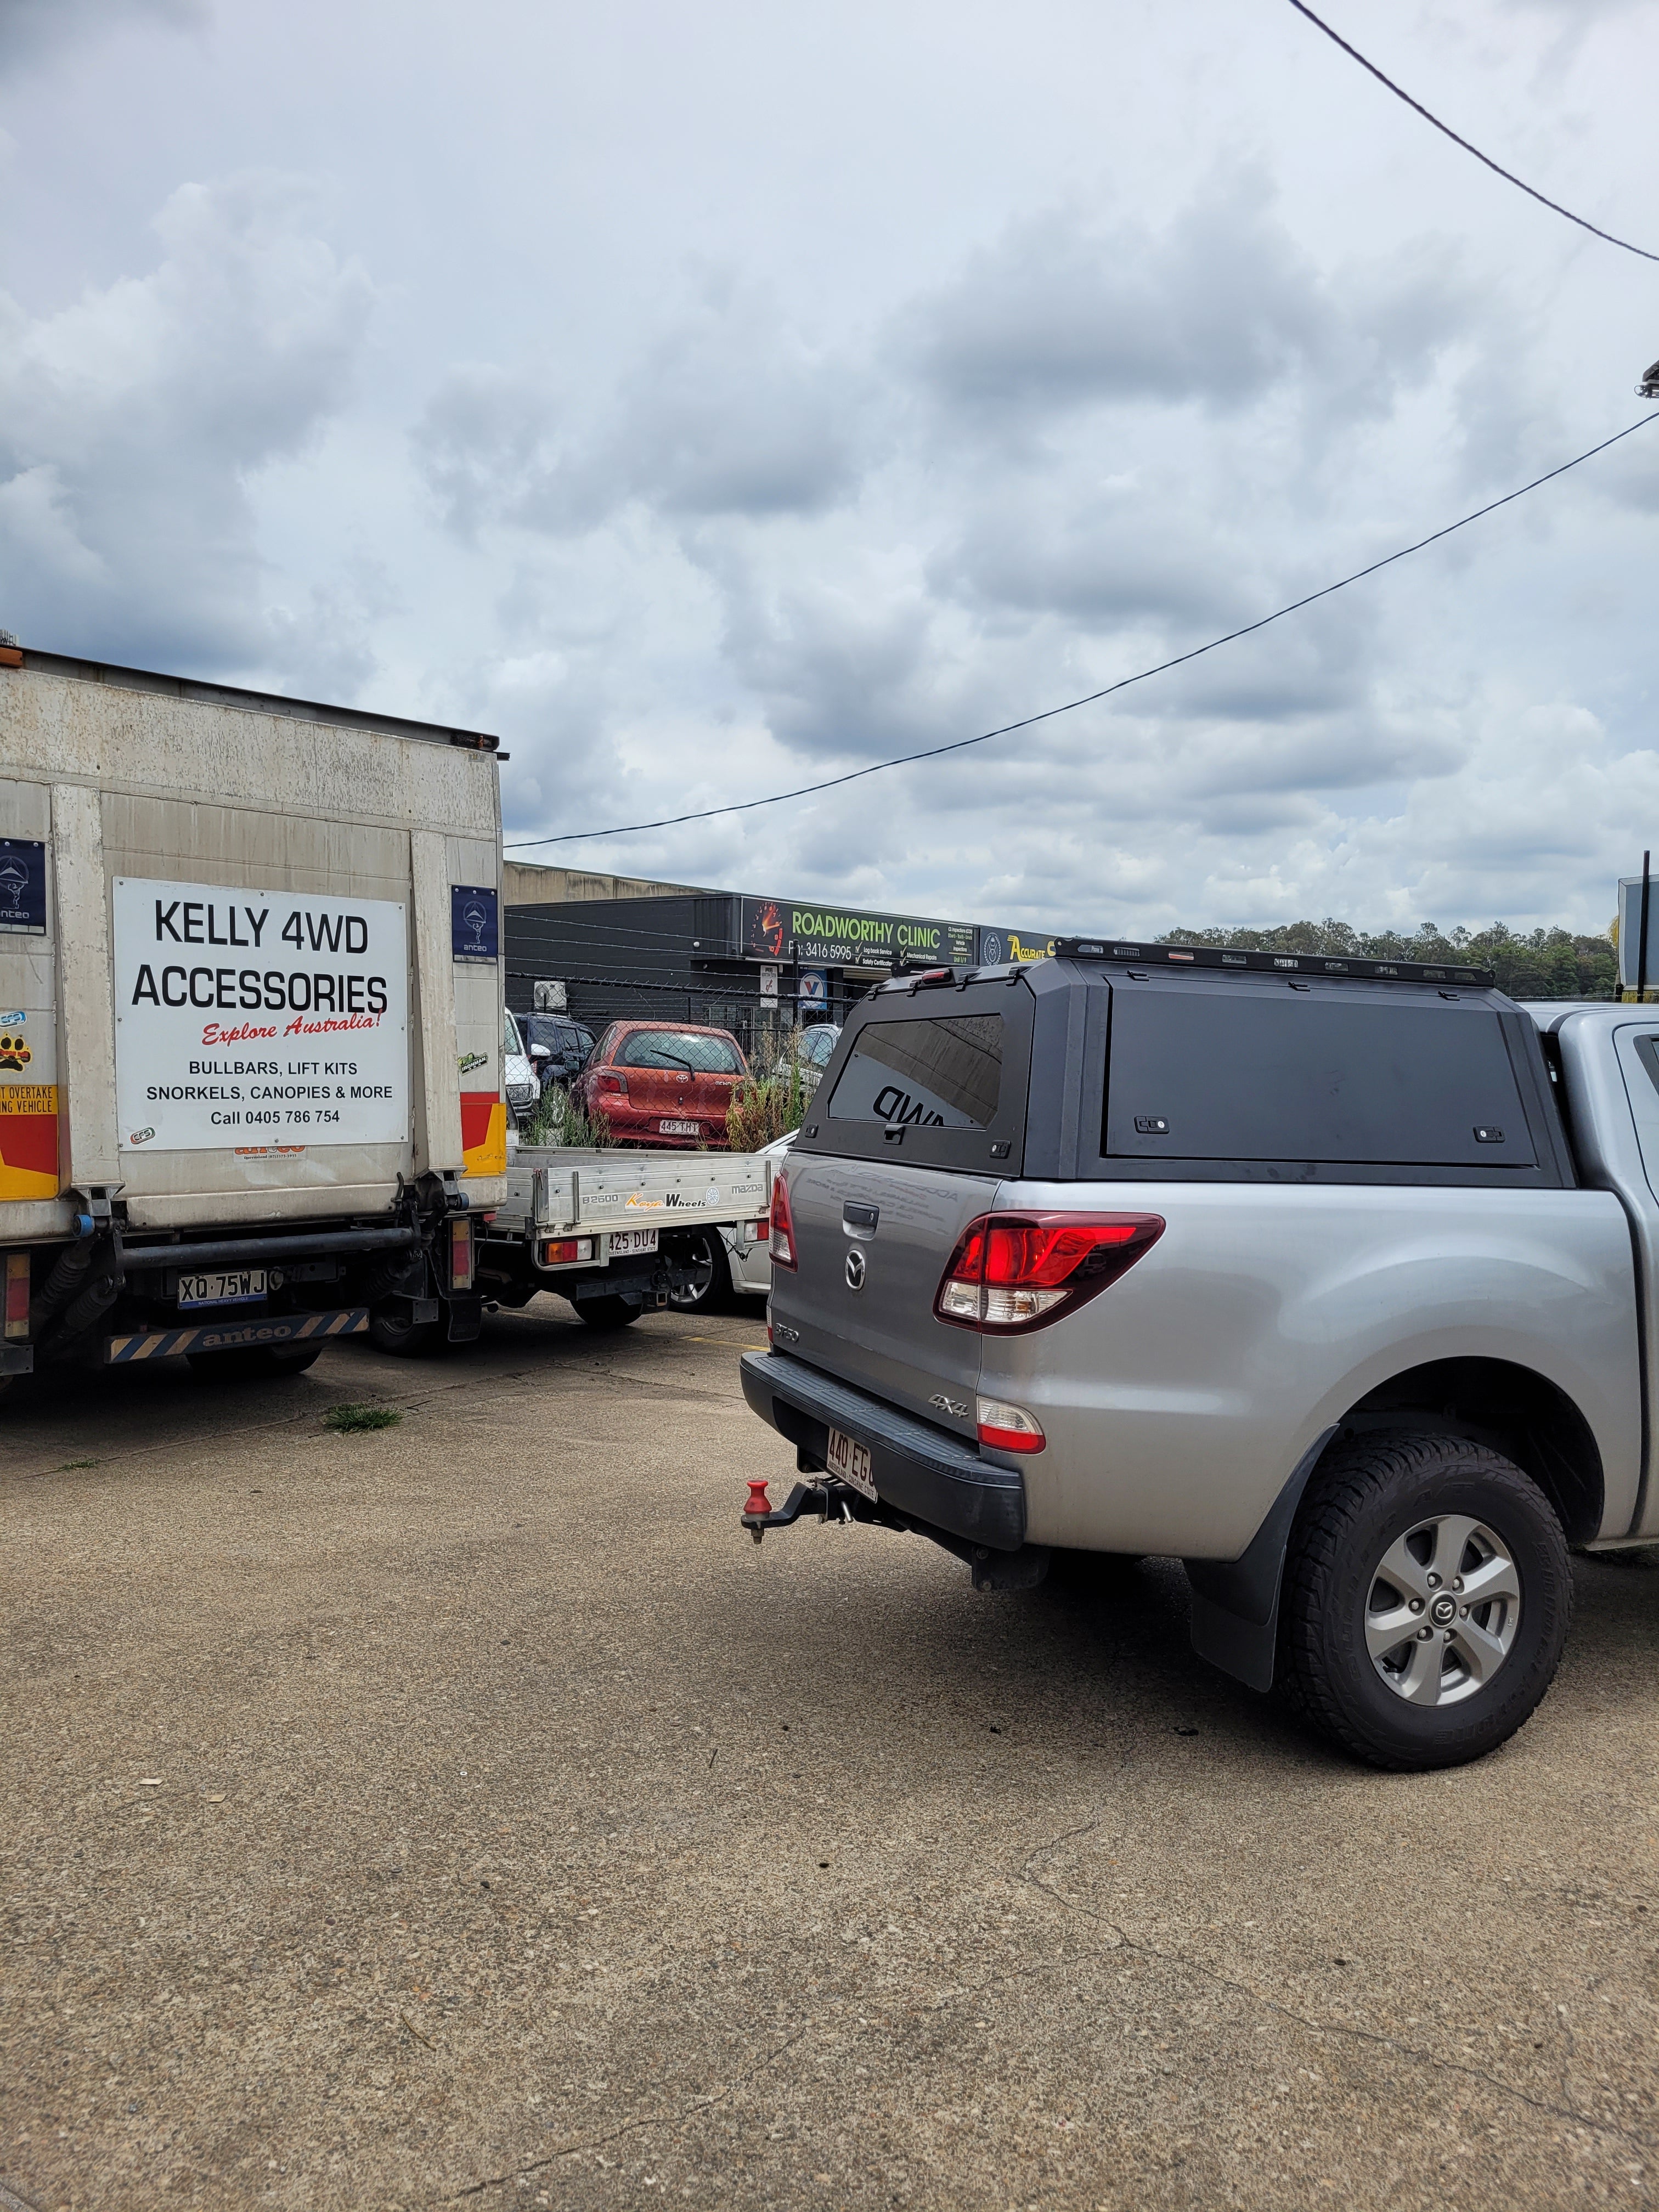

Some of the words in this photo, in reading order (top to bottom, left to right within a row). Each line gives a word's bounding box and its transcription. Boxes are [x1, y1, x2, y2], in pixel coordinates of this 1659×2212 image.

[155, 900, 269, 947] KELLY
[281, 912, 368, 954] 4WD
[792, 911, 894, 944] ROADWORTHY
[897, 924, 940, 949] CLINIC
[463, 944, 487, 952] anteo
[806, 942, 828, 957] 3416
[830, 945, 851, 960] 5995
[131, 964, 387, 1013] ACCESSORIES
[201, 1020, 278, 1047] Explore
[283, 1009, 383, 1037] Australia!
[189, 1061, 283, 1076] BULLBARS,
[288, 1062, 319, 1075] LIFT
[324, 1062, 358, 1075] KITS
[461, 1057, 486, 1071] IRONMAN
[9, 1086, 53, 1099] OVERTAKE
[146, 1086, 245, 1101] SNORKELS,
[250, 1086, 332, 1099] CANOPIES
[335, 1086, 346, 1099] &
[350, 1086, 393, 1099] MORE
[17, 1101, 52, 1113] VEHICLE
[211, 1111, 241, 1125] Call
[245, 1110, 281, 1124] 0405
[285, 1110, 311, 1124] 786
[314, 1110, 340, 1124] 754
[582, 1194, 618, 1205] B2600
[666, 1193, 707, 1207] Wheels
[202, 1325, 292, 1347] anteo
[864, 1486, 874, 1498] STATE
